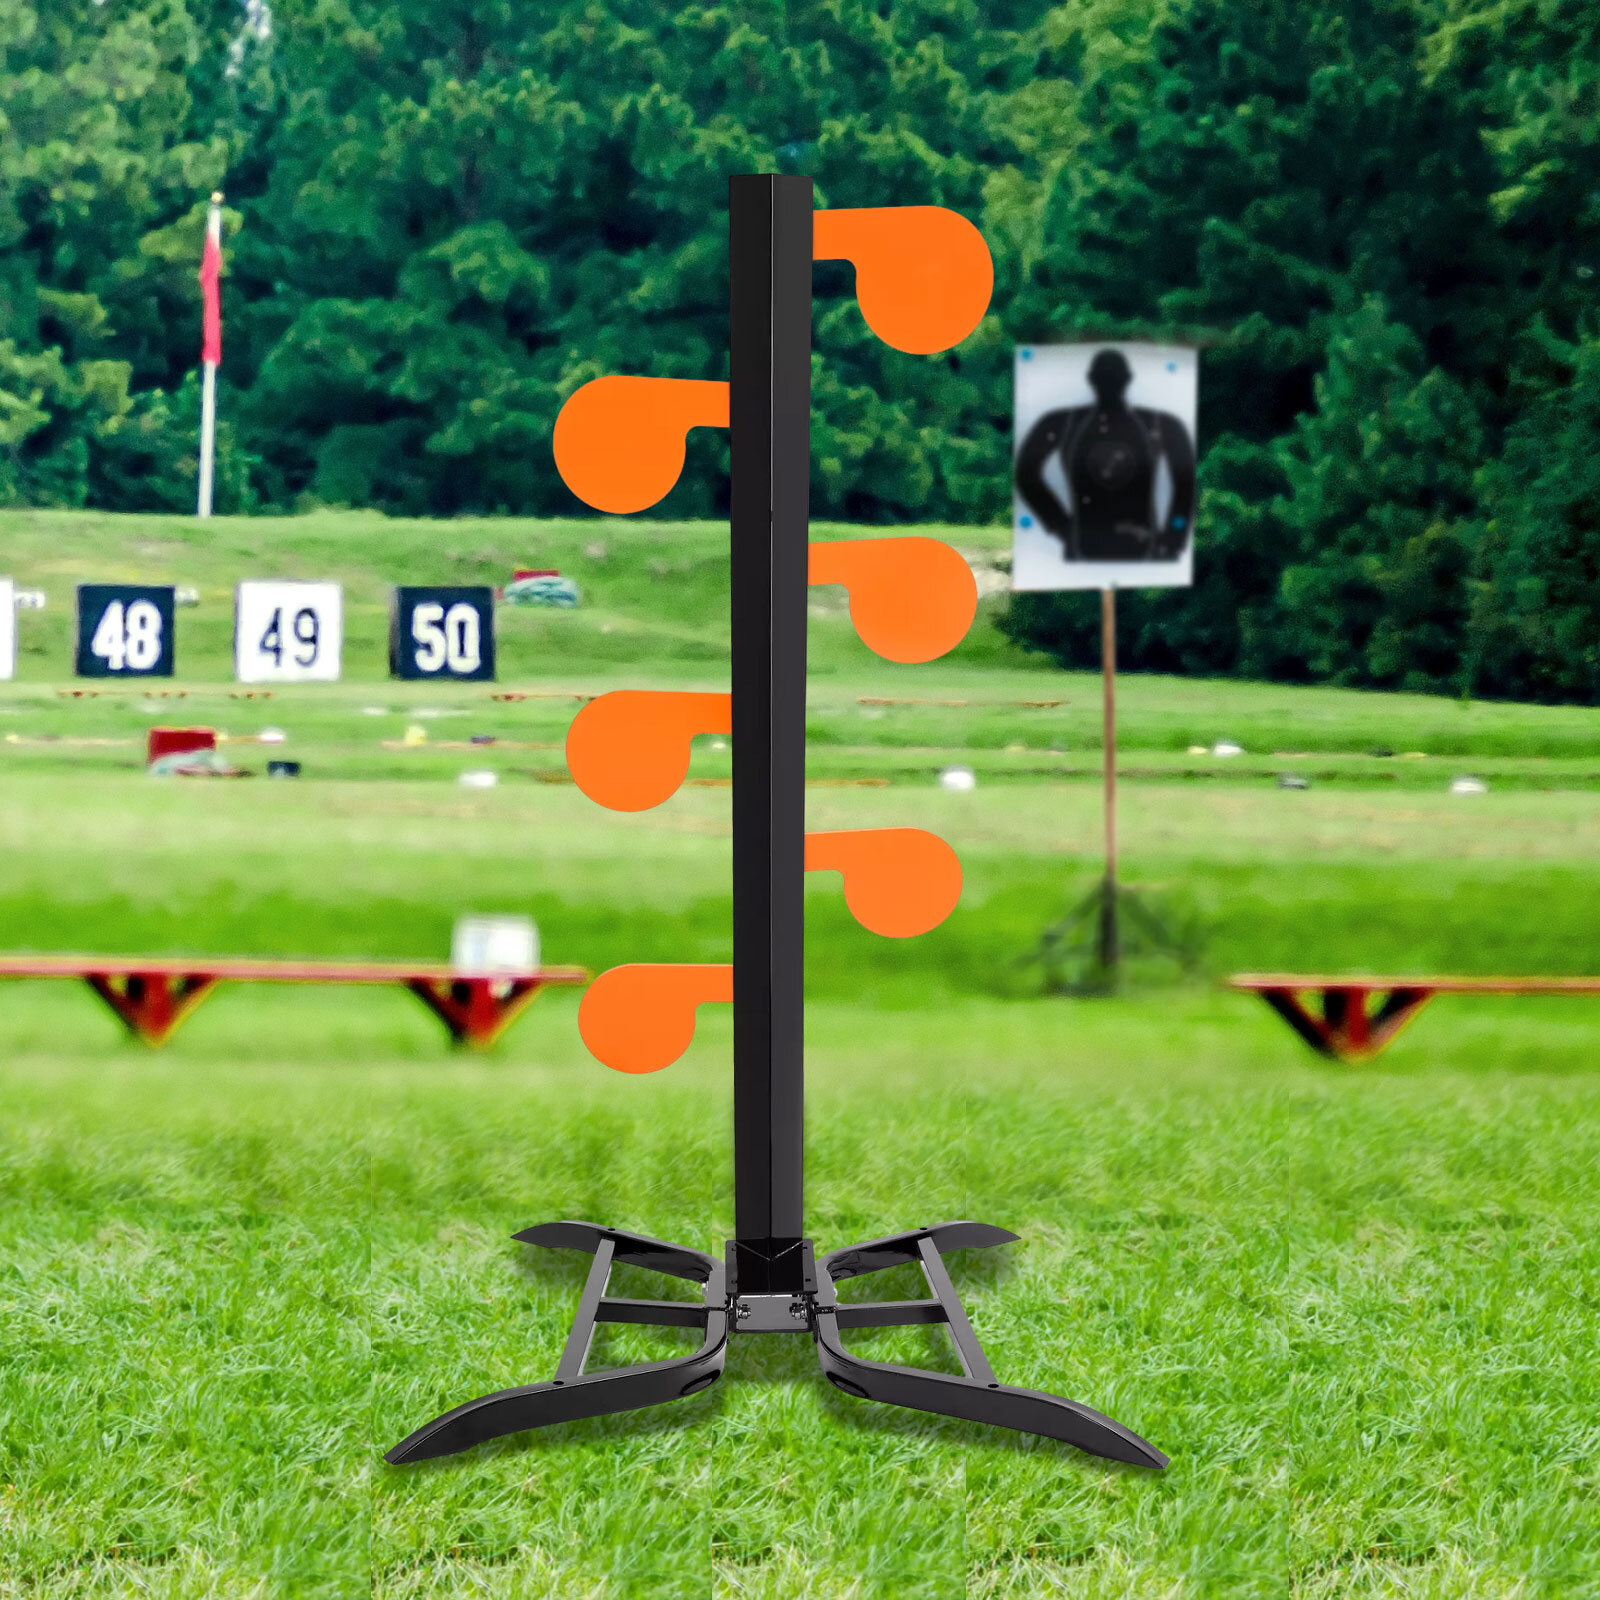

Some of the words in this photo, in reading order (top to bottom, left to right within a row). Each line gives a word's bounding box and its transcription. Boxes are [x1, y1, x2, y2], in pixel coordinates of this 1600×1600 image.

[91, 599, 162, 670] 48
[259, 607, 320, 667] 49
[411, 602, 481, 673] 50
